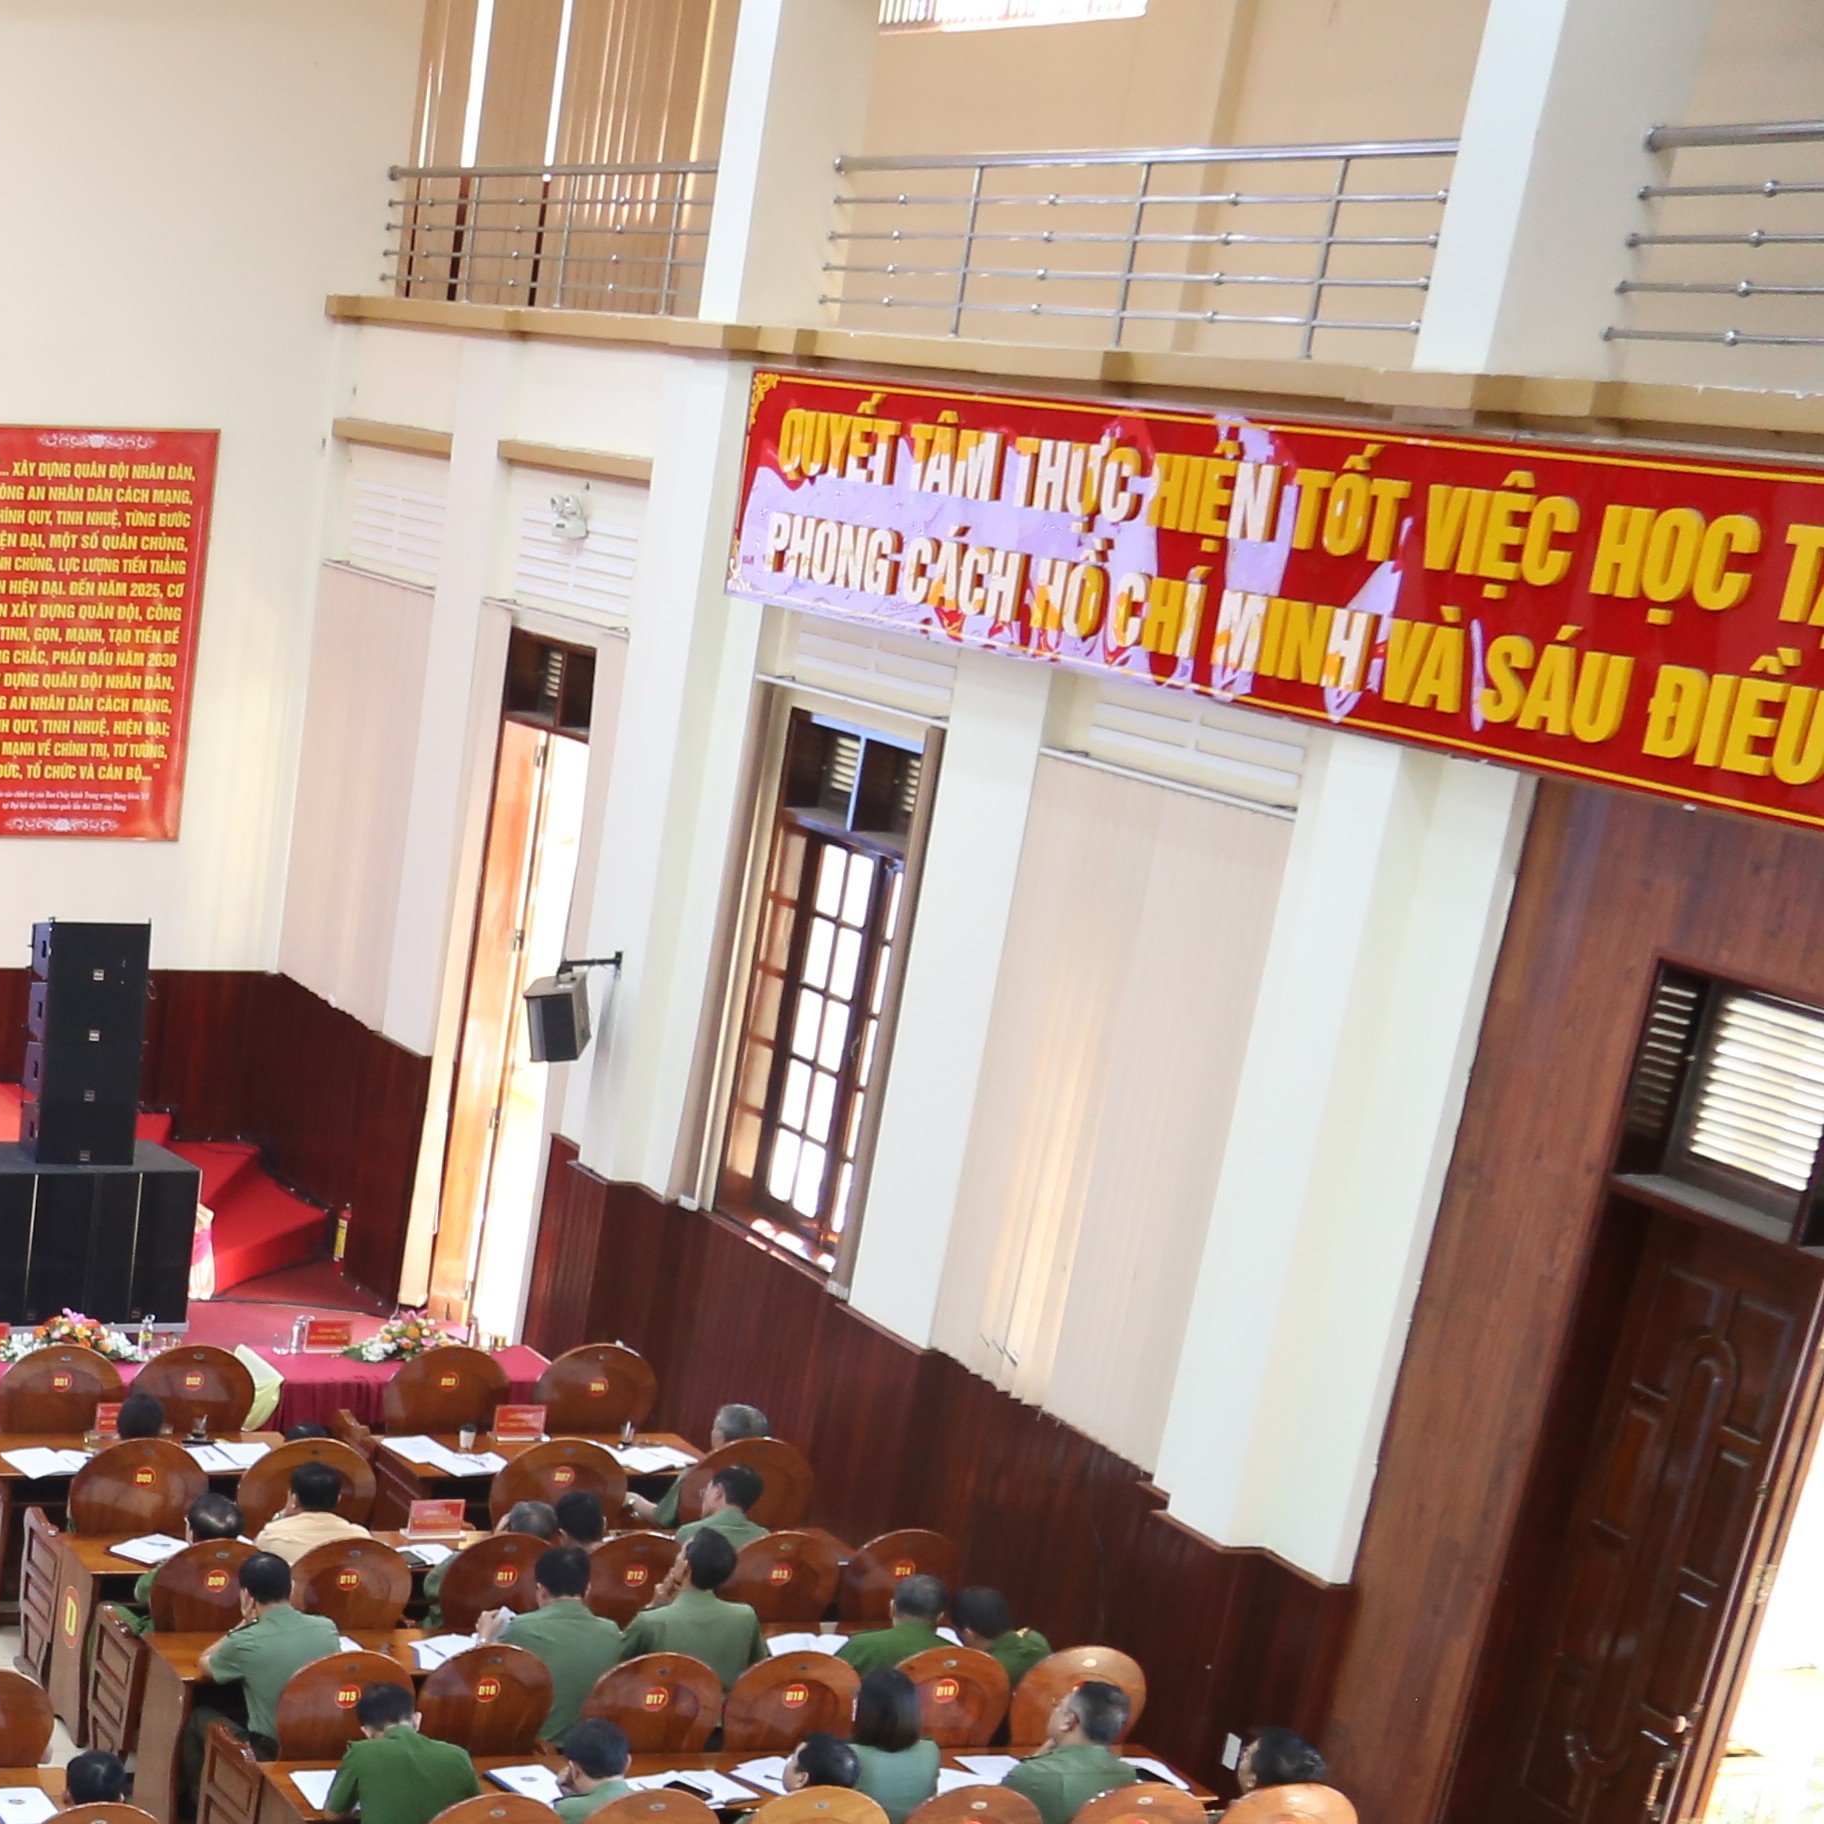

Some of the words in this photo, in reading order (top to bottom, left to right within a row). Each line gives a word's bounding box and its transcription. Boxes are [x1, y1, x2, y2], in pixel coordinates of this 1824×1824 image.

[779, 392, 901, 486] QUYẾT
[910, 409, 1003, 502] TÂM
[1015, 427, 1143, 533] THỰC
[1145, 439, 1282, 553] HIỆN
[1291, 444, 1413, 563] TỐT
[1424, 470, 1580, 599] VIỆC
[1590, 504, 1762, 625] HỌC
[768, 511, 905, 596] PHONG
[905, 525, 1029, 622] CÁCH
[1029, 538, 1114, 638] HỒ
[1117, 565, 1213, 659] CHÍ
[1212, 588, 1375, 692] MINH
[1382, 605, 1466, 714] VÀ
[1479, 625, 1635, 744] SÁU
[1641, 647, 1824, 786] ĐIỀU
[64, 1601, 78, 1636] D
[645, 1693, 665, 1705] D17
